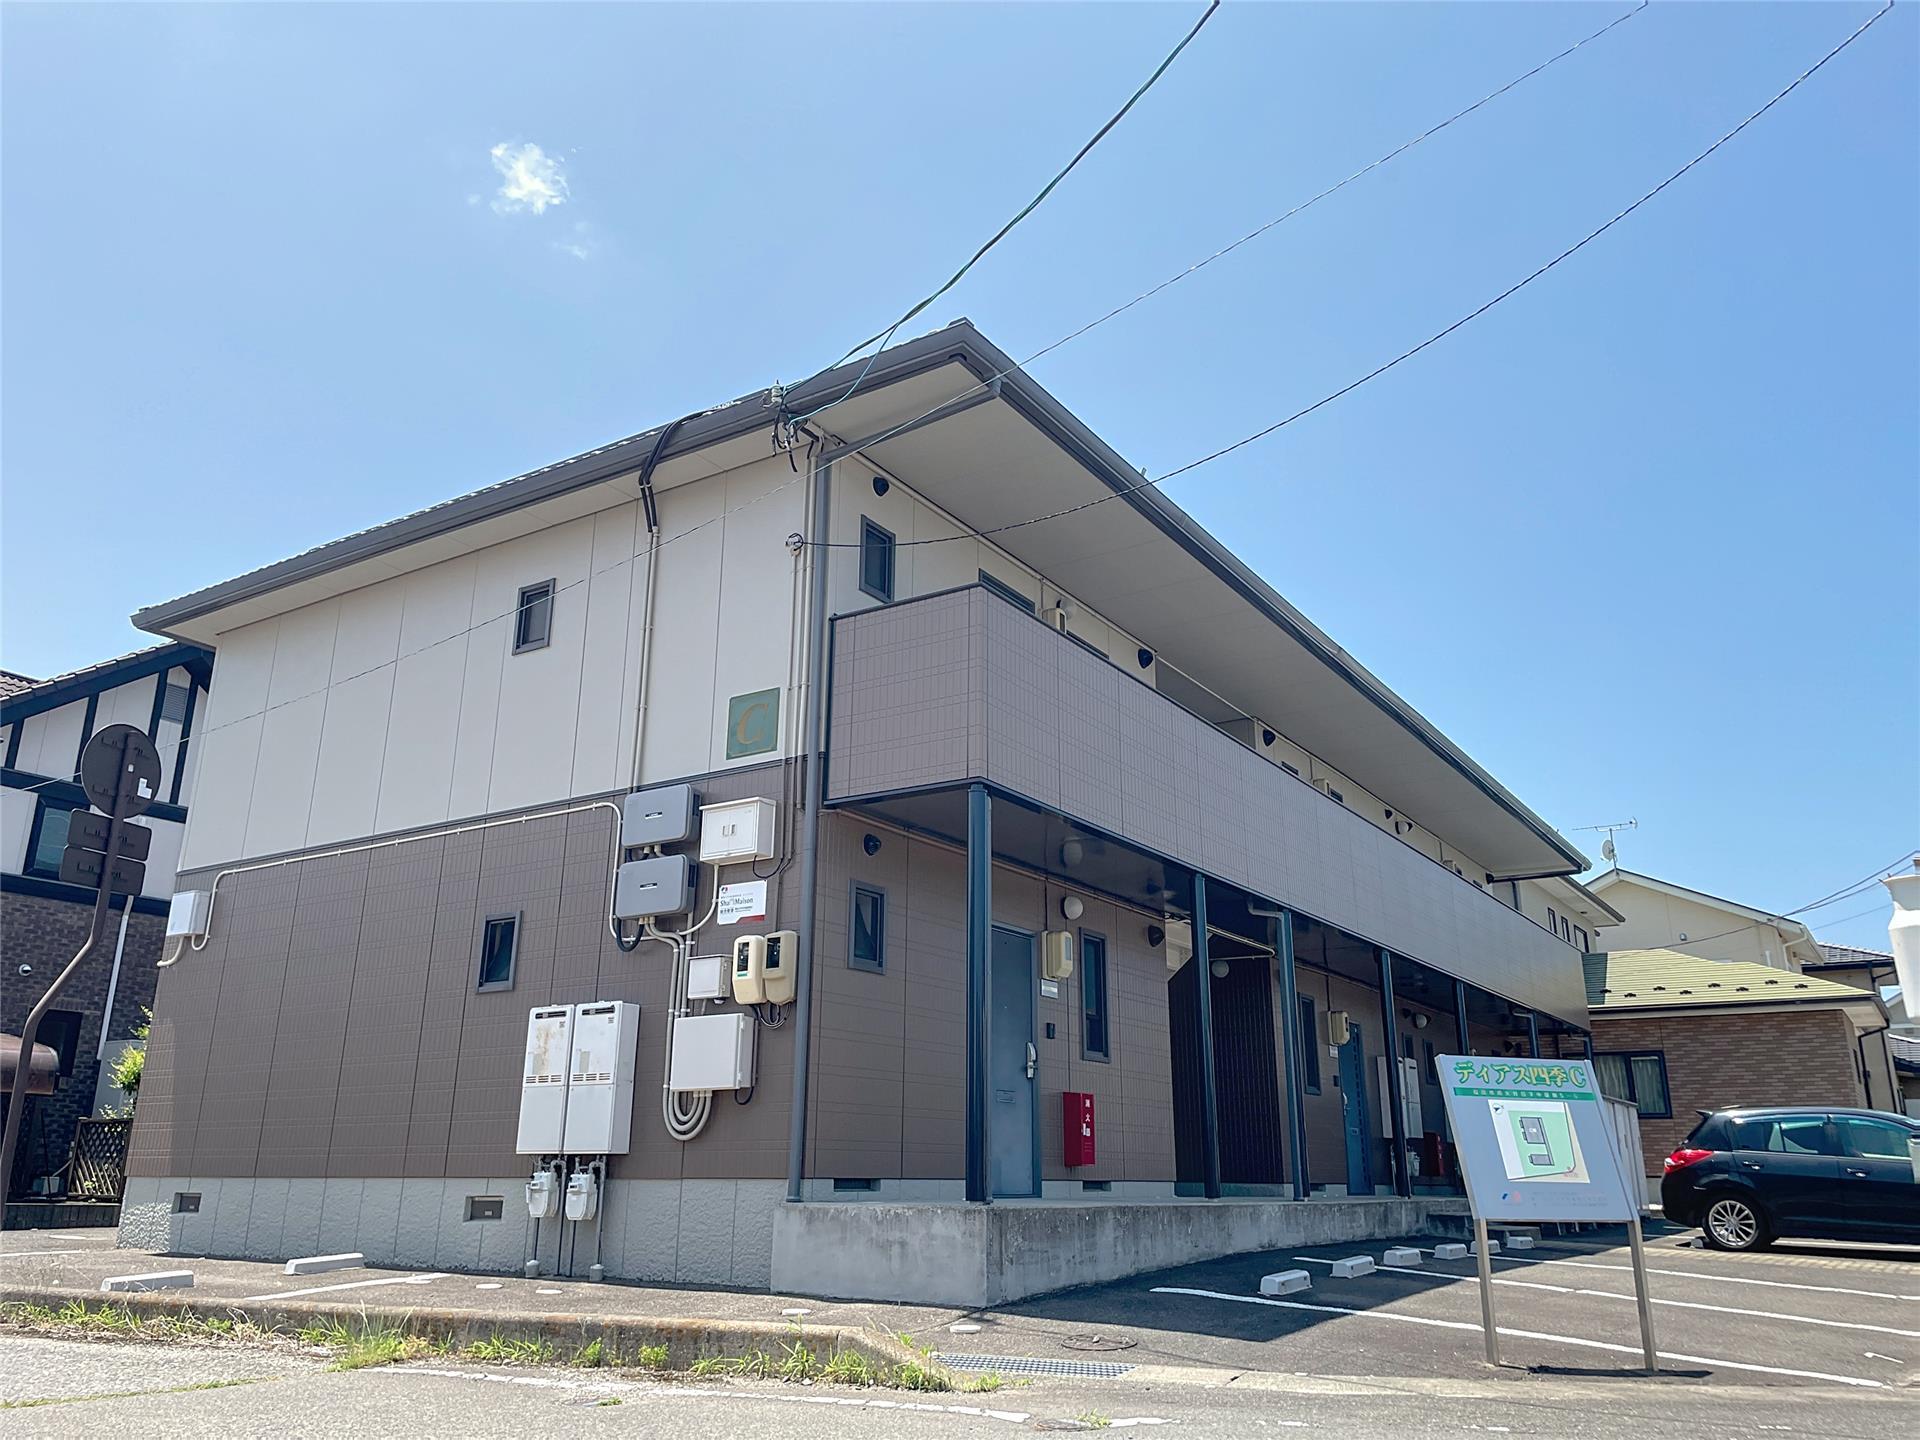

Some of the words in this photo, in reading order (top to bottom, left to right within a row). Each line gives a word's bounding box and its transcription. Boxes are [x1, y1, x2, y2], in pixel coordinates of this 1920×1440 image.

[736, 703, 768, 744] C
[1455, 1061, 1586, 1088] ディアス四季C
